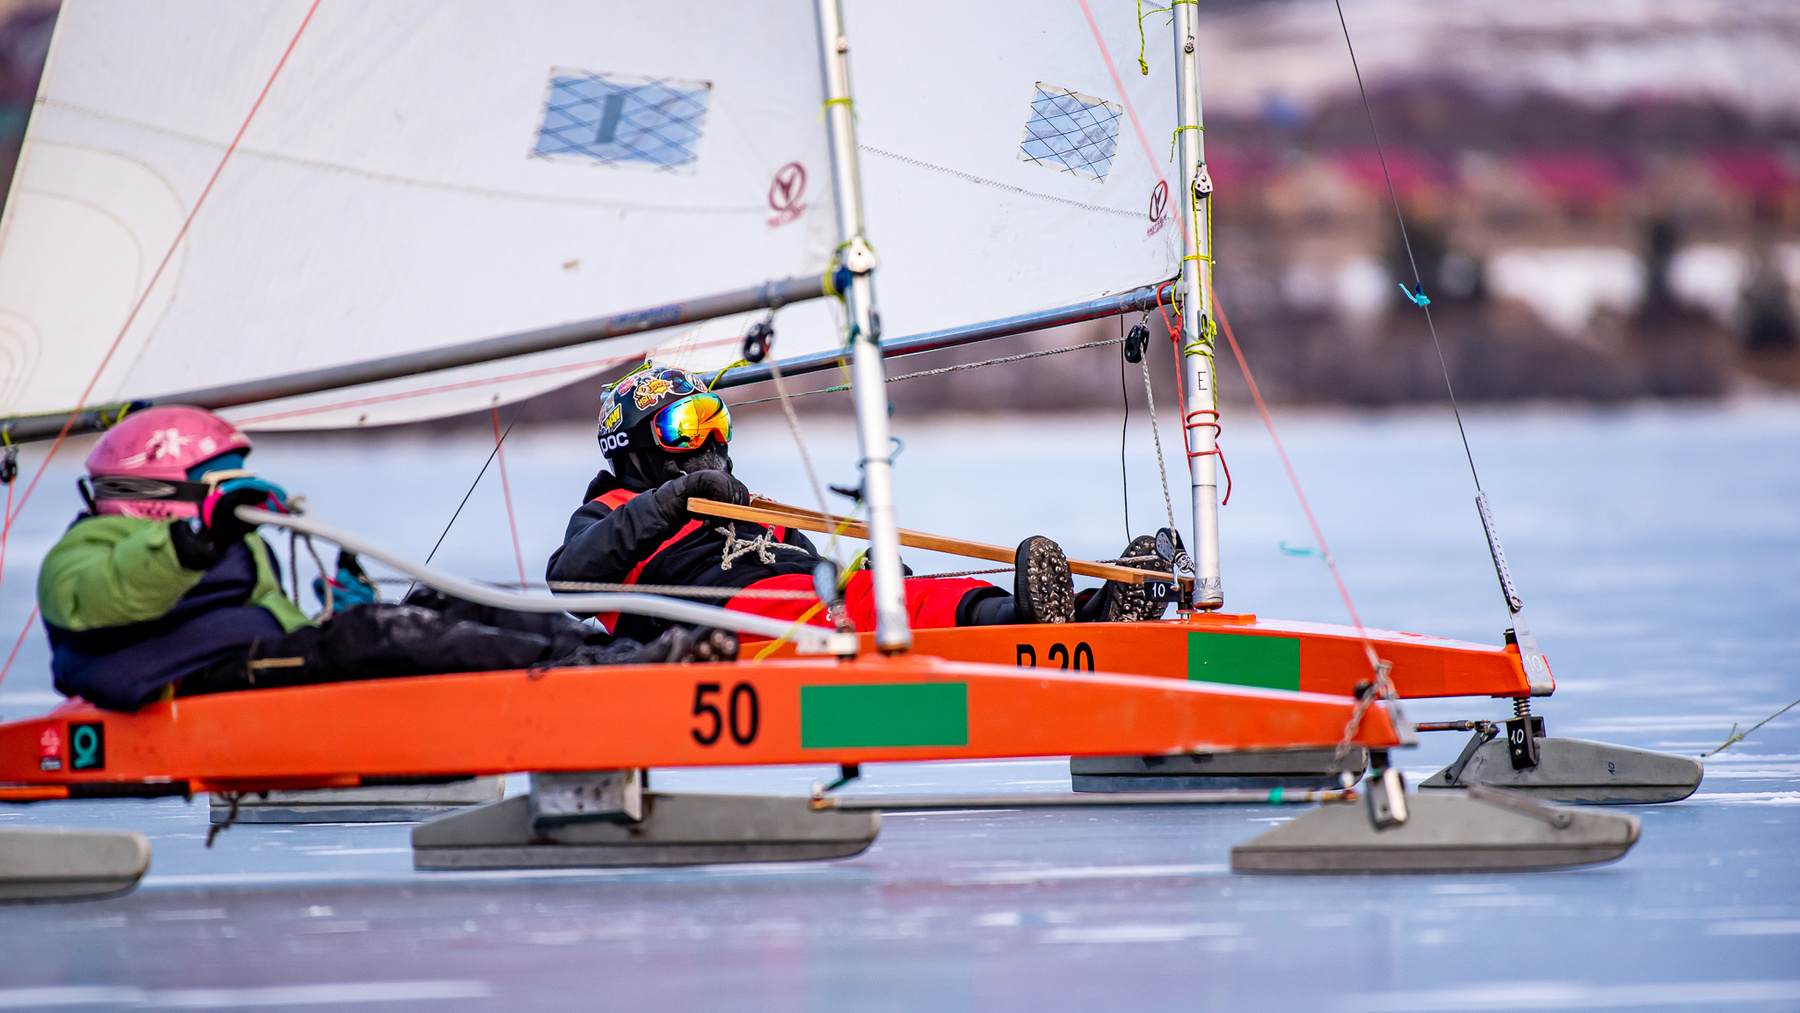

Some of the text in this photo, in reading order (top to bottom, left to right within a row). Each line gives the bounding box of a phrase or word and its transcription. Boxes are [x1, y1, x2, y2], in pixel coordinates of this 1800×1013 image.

[1197, 371, 1208, 391] E
[1152, 582, 1166, 598] 10
[1048, 641, 1095, 676] 20
[1525, 654, 1543, 673] 10
[691, 682, 760, 747] 50
[1510, 728, 1525, 745] 10
